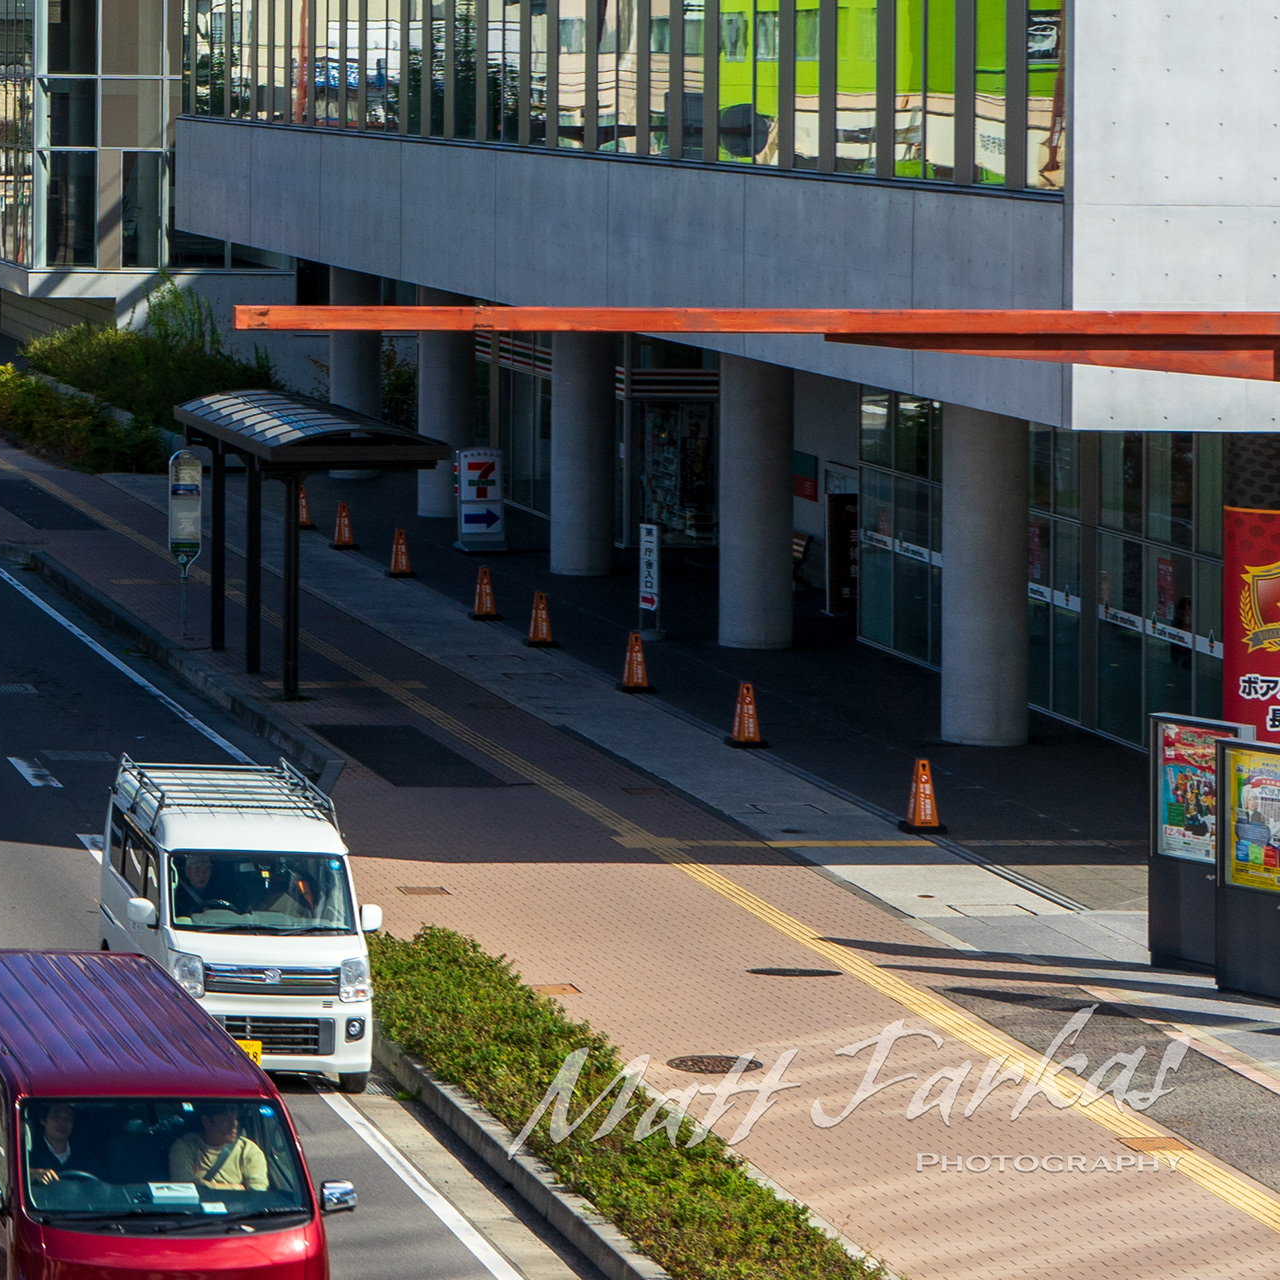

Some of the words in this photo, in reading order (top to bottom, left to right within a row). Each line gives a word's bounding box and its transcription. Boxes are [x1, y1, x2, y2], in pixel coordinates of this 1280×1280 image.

[644, 527, 653, 589] 第一庁舎入口
